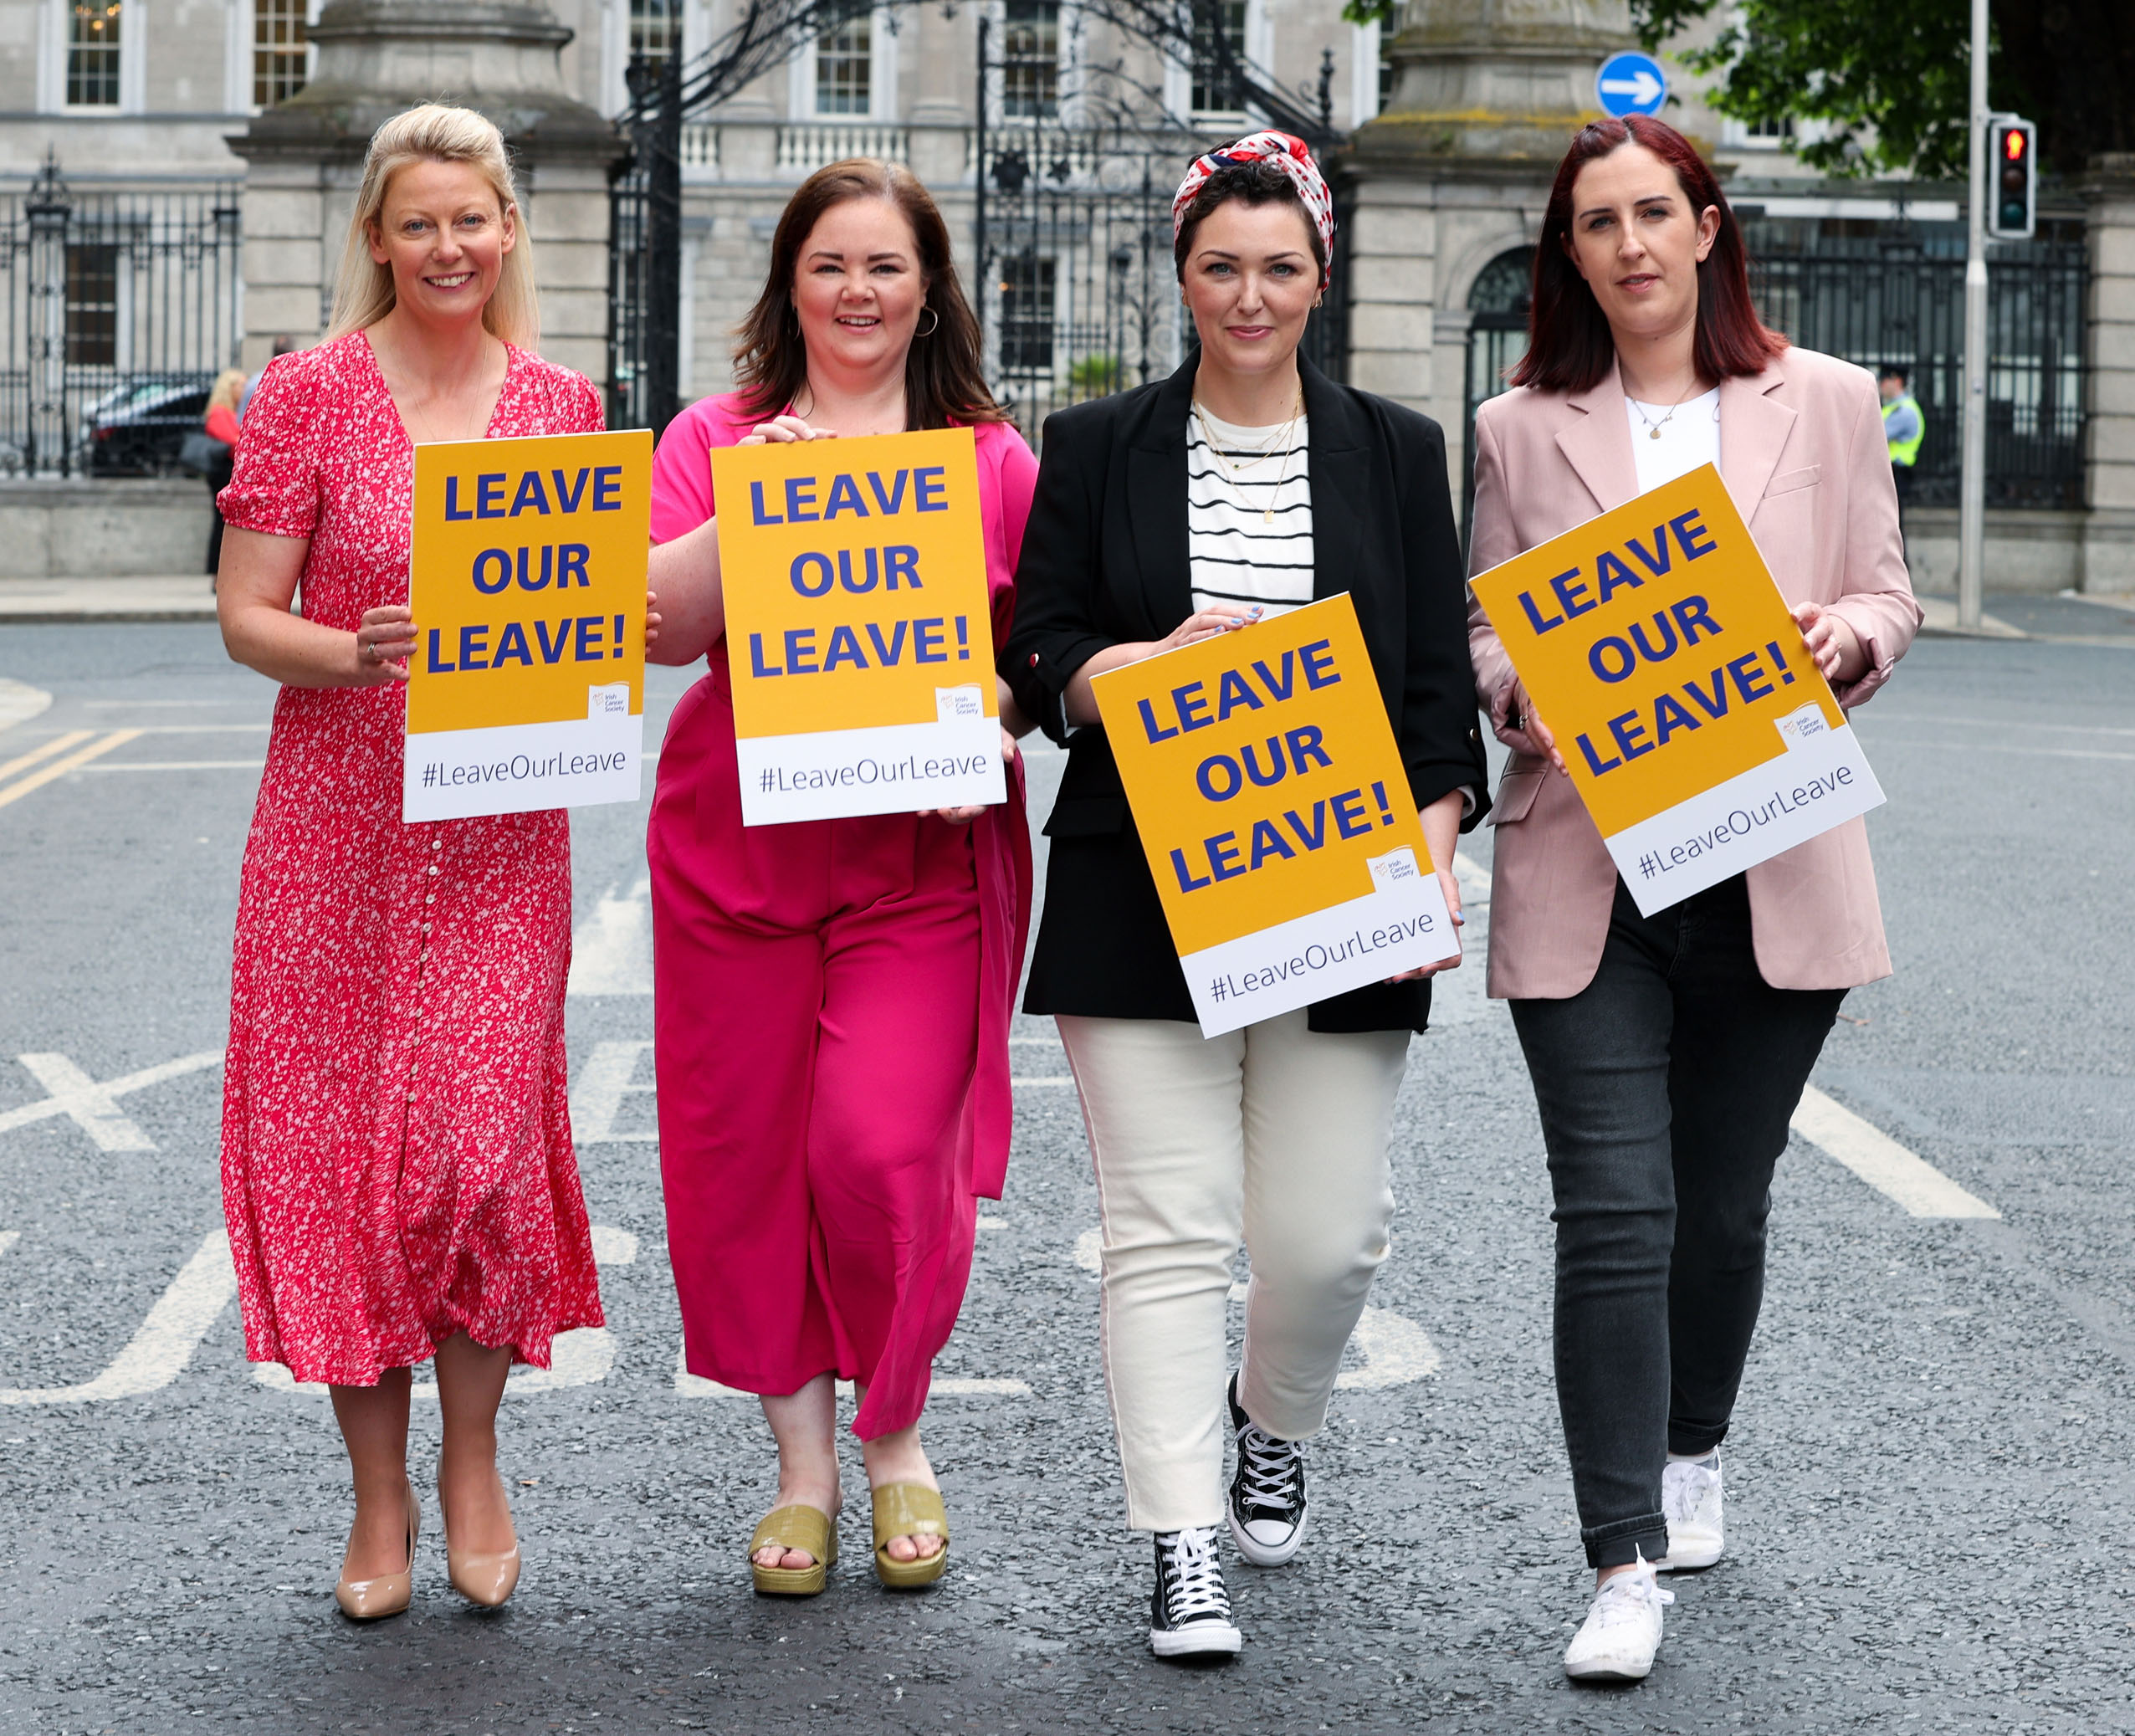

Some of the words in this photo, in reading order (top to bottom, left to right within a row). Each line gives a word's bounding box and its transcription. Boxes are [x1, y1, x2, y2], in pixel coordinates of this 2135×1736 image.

[445, 465, 622, 521] LEAVE
[750, 466, 948, 525] LEAVE
[472, 543, 590, 594] OUR
[790, 545, 923, 597] OUR
[1518, 509, 1717, 634] LEAVE
[428, 614, 624, 673] LEAVE!
[749, 615, 970, 678] LEAVE!
[1588, 595, 1723, 683] OUR
[1137, 638, 1341, 744] LEAVE
[1575, 641, 1795, 776] LEAVE!
[421, 750, 626, 788] #LeaveOurLeave
[759, 755, 986, 793] #LeaveOurLeave
[1195, 725, 1333, 801] OUR
[1170, 781, 1394, 893] LEAVE!
[1638, 766, 1854, 880] #LeaveOurLeave
[1210, 913, 1434, 1003] #LeaveOurLeave
